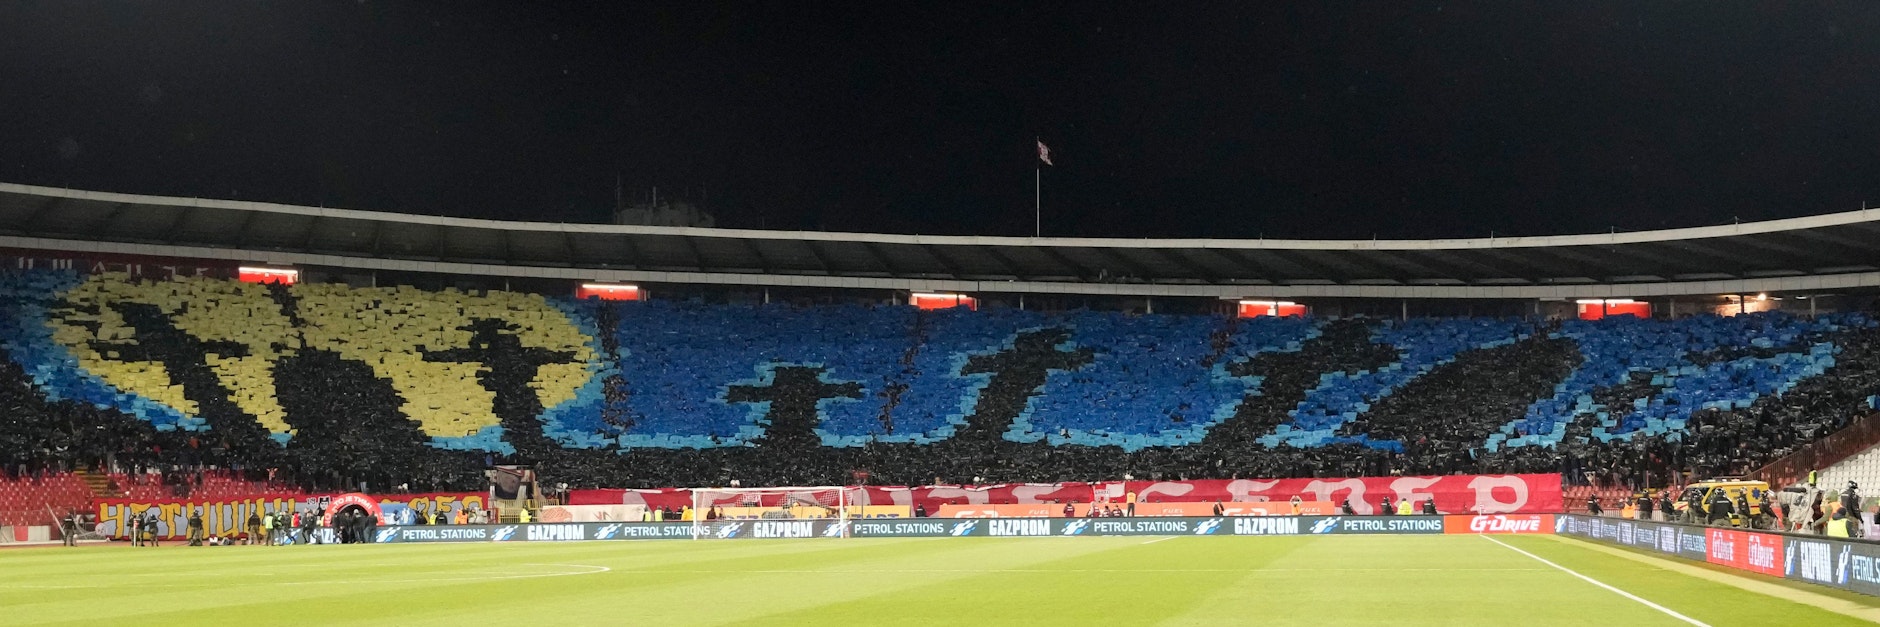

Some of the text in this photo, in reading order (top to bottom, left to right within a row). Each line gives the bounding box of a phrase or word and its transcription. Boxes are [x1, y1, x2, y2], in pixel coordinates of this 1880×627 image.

[753, 522, 813, 538] GAZPROM
[854, 522, 944, 534] PETROL STATIONS
[988, 519, 1050, 536] GAZPROM
[1093, 521, 1188, 532] PETROL STATIONS
[1234, 517, 1299, 535] GAZPROM
[1343, 519, 1442, 531] PETROL STATIONS
[402, 528, 486, 540] PETROL STATIONS
[527, 524, 585, 541] GAZPROM
[624, 526, 662, 537] PETROL
